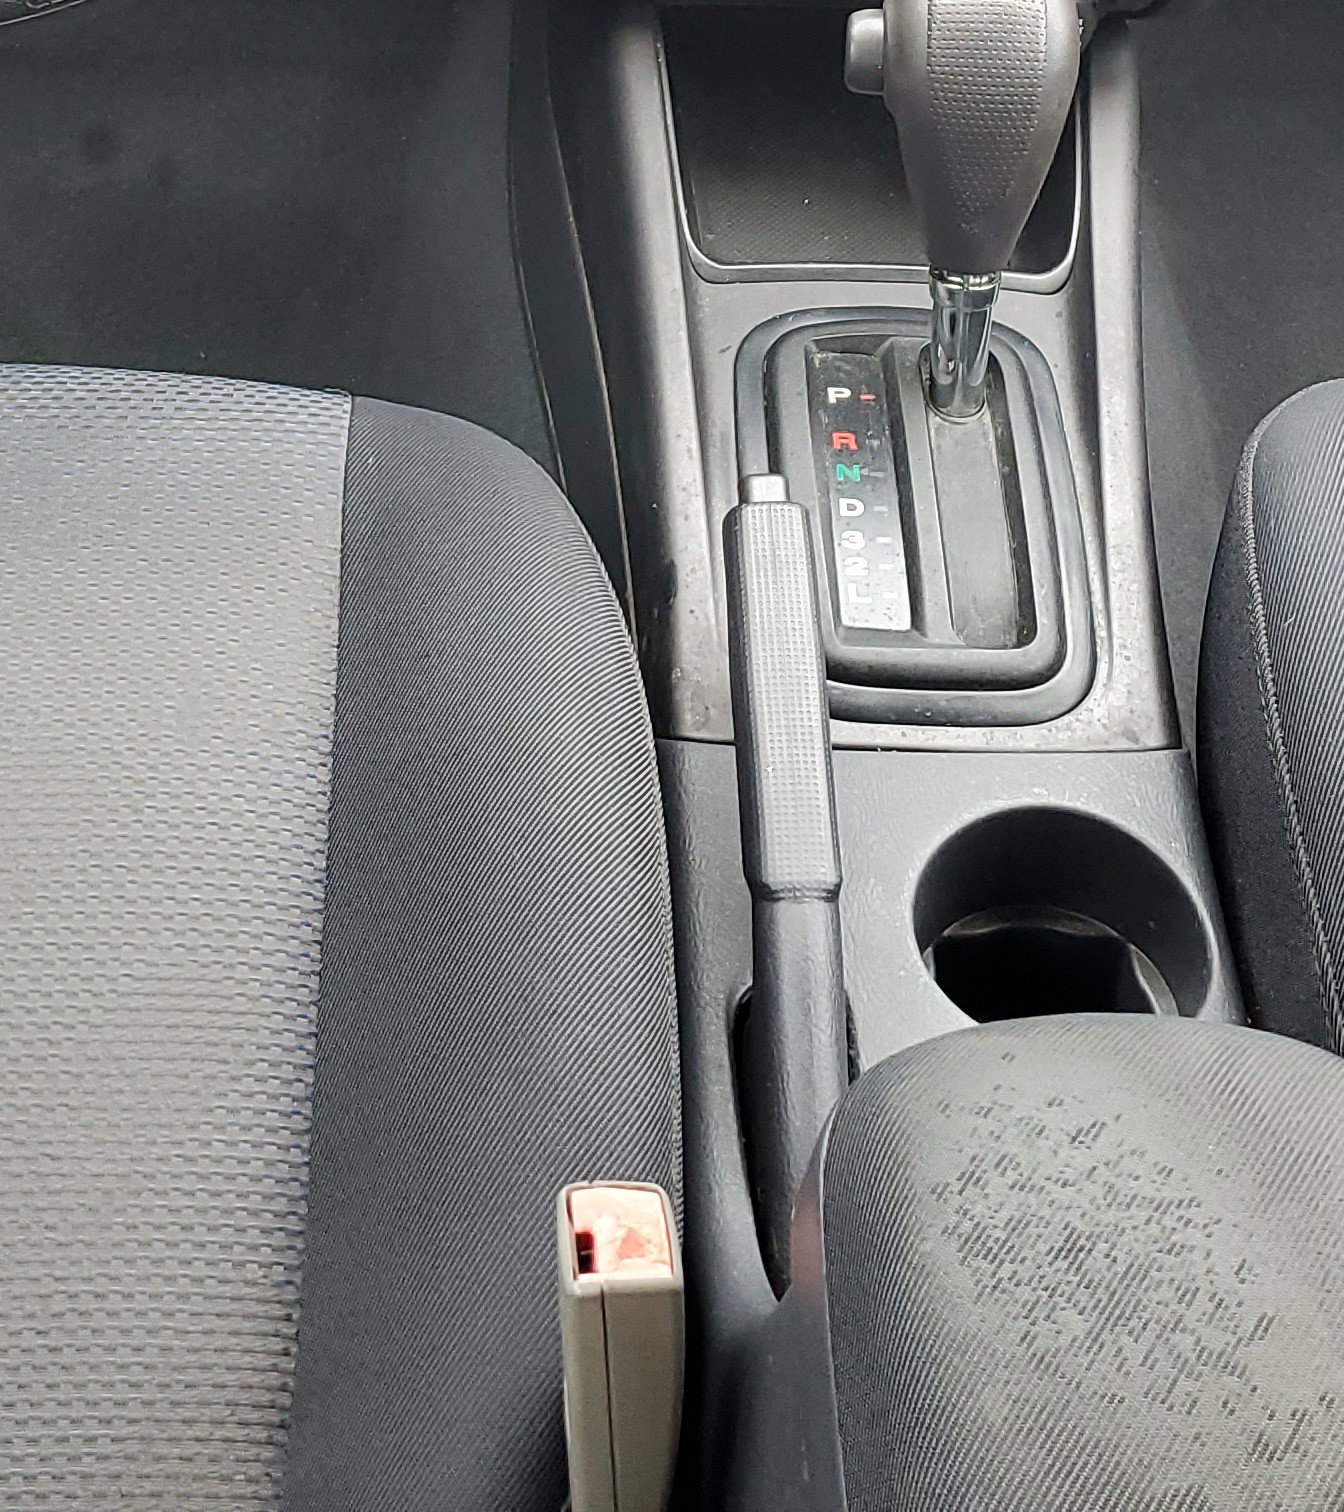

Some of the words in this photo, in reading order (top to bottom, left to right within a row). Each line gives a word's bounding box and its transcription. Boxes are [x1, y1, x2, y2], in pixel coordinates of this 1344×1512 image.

[827, 386, 852, 404] P
[832, 431, 858, 451] R
[836, 463, 861, 482] N
[838, 497, 865, 517] D
[841, 530, 866, 551] 3
[844, 555, 869, 577] 2
[846, 582, 873, 605] L
